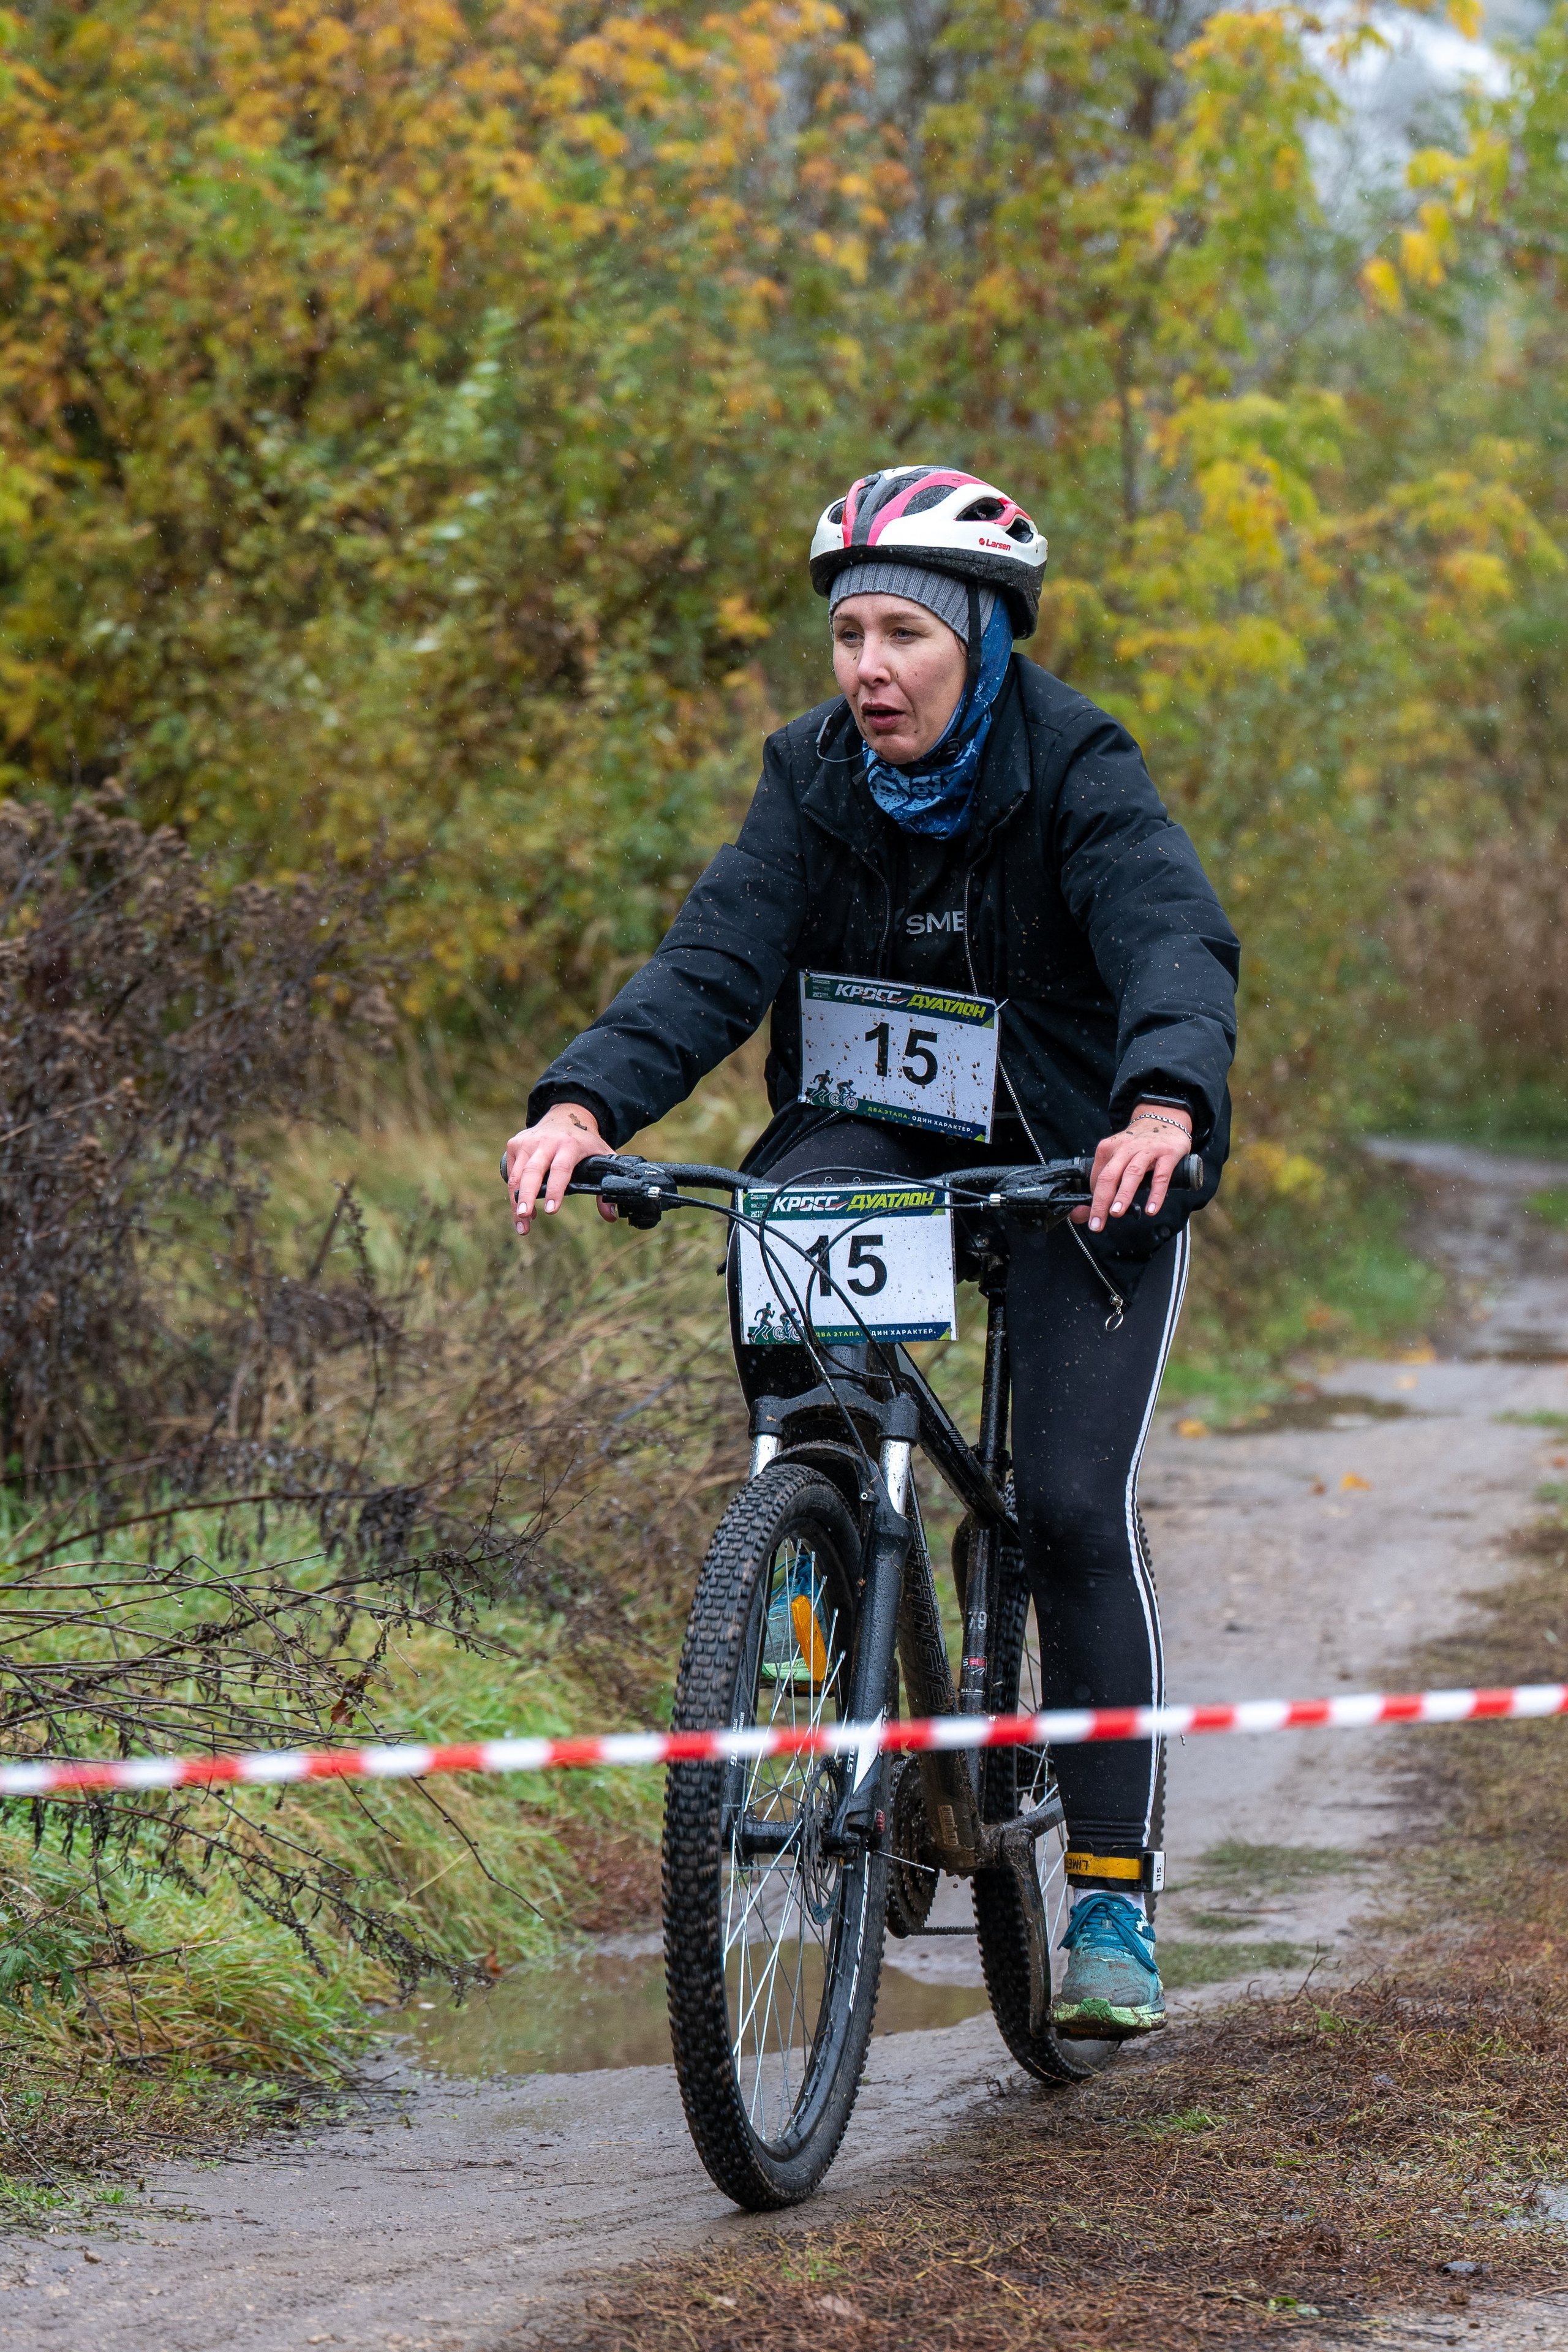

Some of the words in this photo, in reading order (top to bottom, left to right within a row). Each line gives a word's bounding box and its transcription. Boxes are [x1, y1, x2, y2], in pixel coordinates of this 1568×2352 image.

[986, 538, 1011, 551] Larsen
[834, 983, 903, 1005] КРОСС
[907, 994, 987, 1019] ДУАТЛОН
[864, 1022, 939, 1086] 15
[884, 1109, 911, 1120] ЭТАПА.
[911, 1115, 933, 1125] ОДИН
[933, 1120, 974, 1134] ХАРАКТЕР.
[772, 1196, 841, 1213] КРОСС
[846, 1192, 935, 1212] ДУАТЛОН
[804, 1234, 888, 1297] 15
[834, 1329, 864, 1338] ЭТАПА.
[846, 1745, 856, 1774] STG
